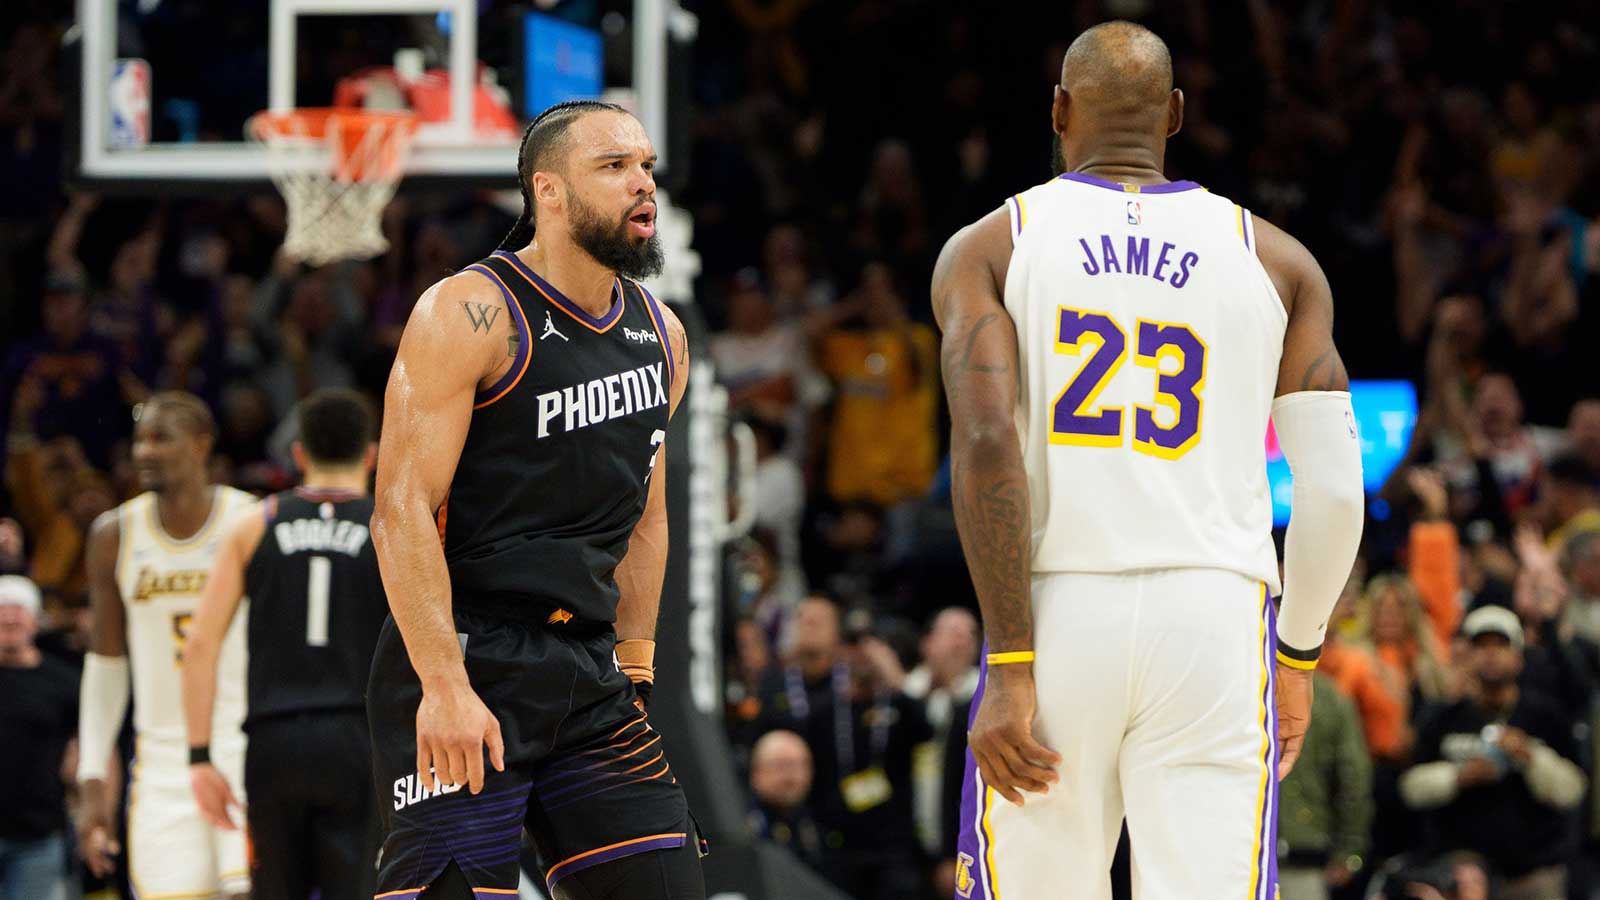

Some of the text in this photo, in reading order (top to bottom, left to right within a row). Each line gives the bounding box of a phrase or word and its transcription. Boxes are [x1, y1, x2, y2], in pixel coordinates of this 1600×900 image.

[1079, 234, 1199, 289] JAMES
[623, 327, 659, 344] PayPal
[536, 362, 668, 439] PHOENIX
[1048, 304, 1209, 461] 23
[306, 556, 331, 647] 1
